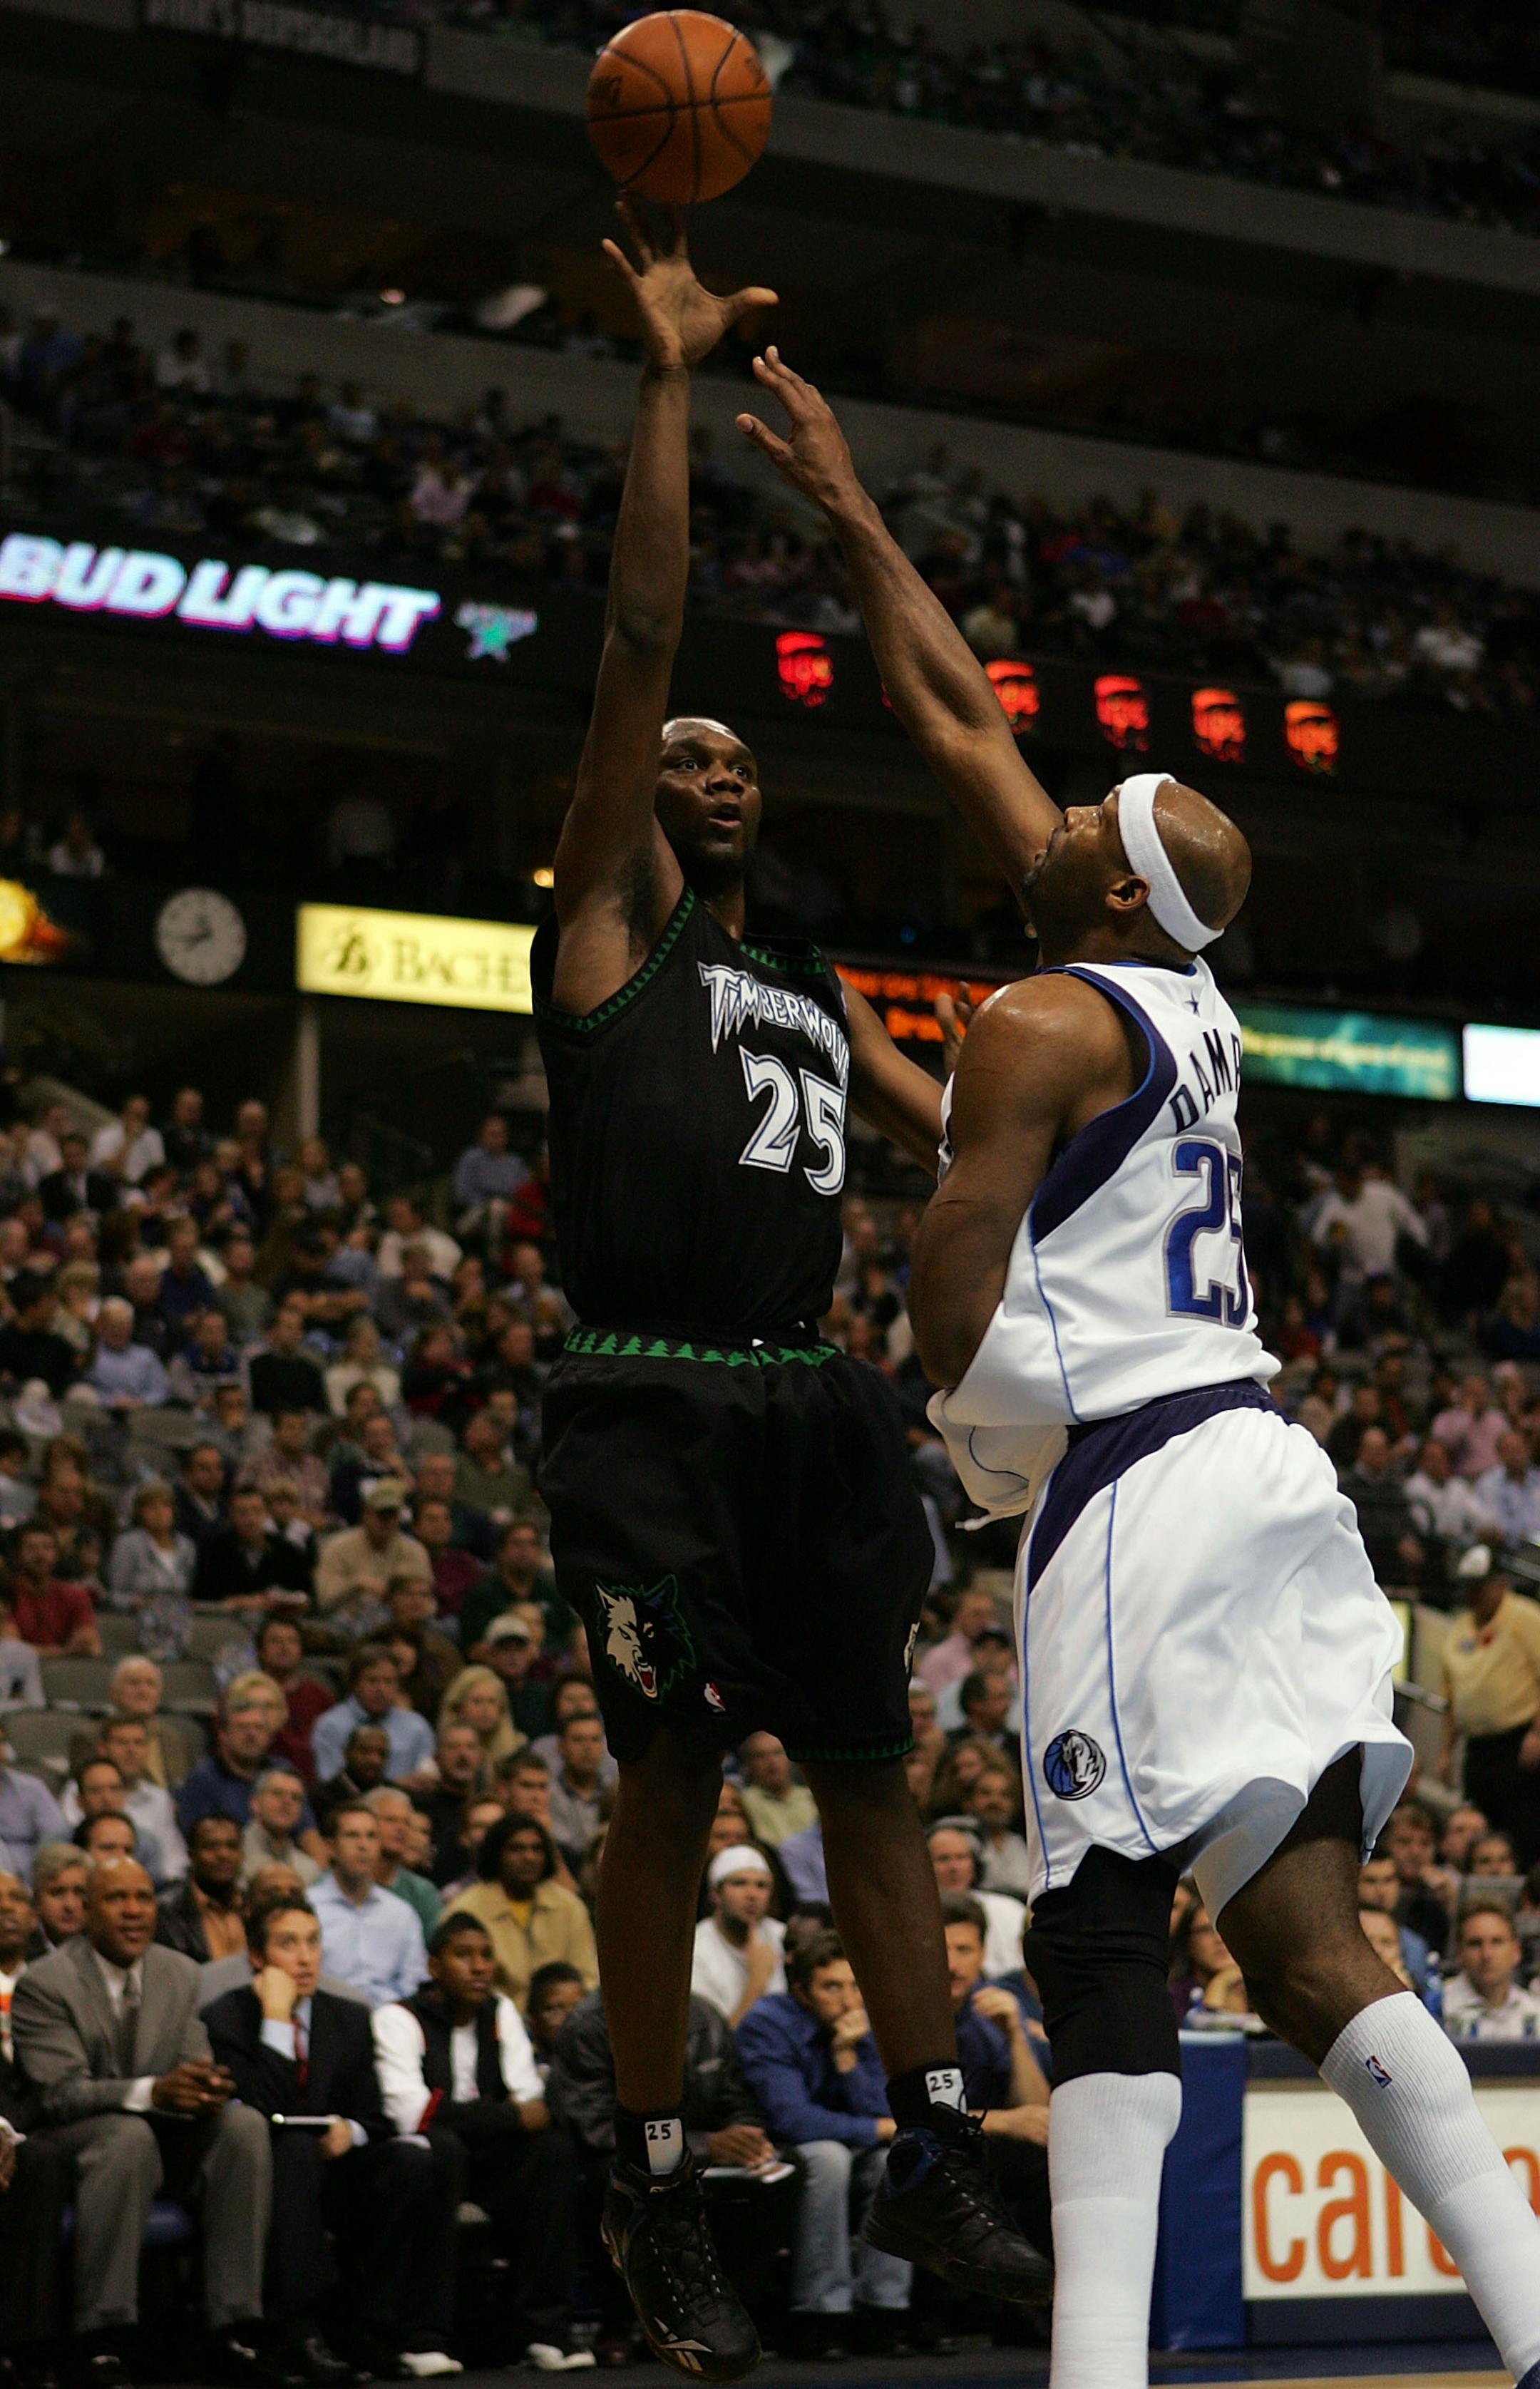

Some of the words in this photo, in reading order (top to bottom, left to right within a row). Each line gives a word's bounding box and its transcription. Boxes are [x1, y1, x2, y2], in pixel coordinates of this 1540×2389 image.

[0, 533, 187, 619] BUD
[175, 559, 442, 654] LIGHT
[697, 960, 850, 1089] TIMBERWOLV
[738, 1044, 847, 1197] 25
[1163, 1135, 1248, 1330] 25
[647, 2123, 672, 2140] 25
[929, 2072, 953, 2092] 25
